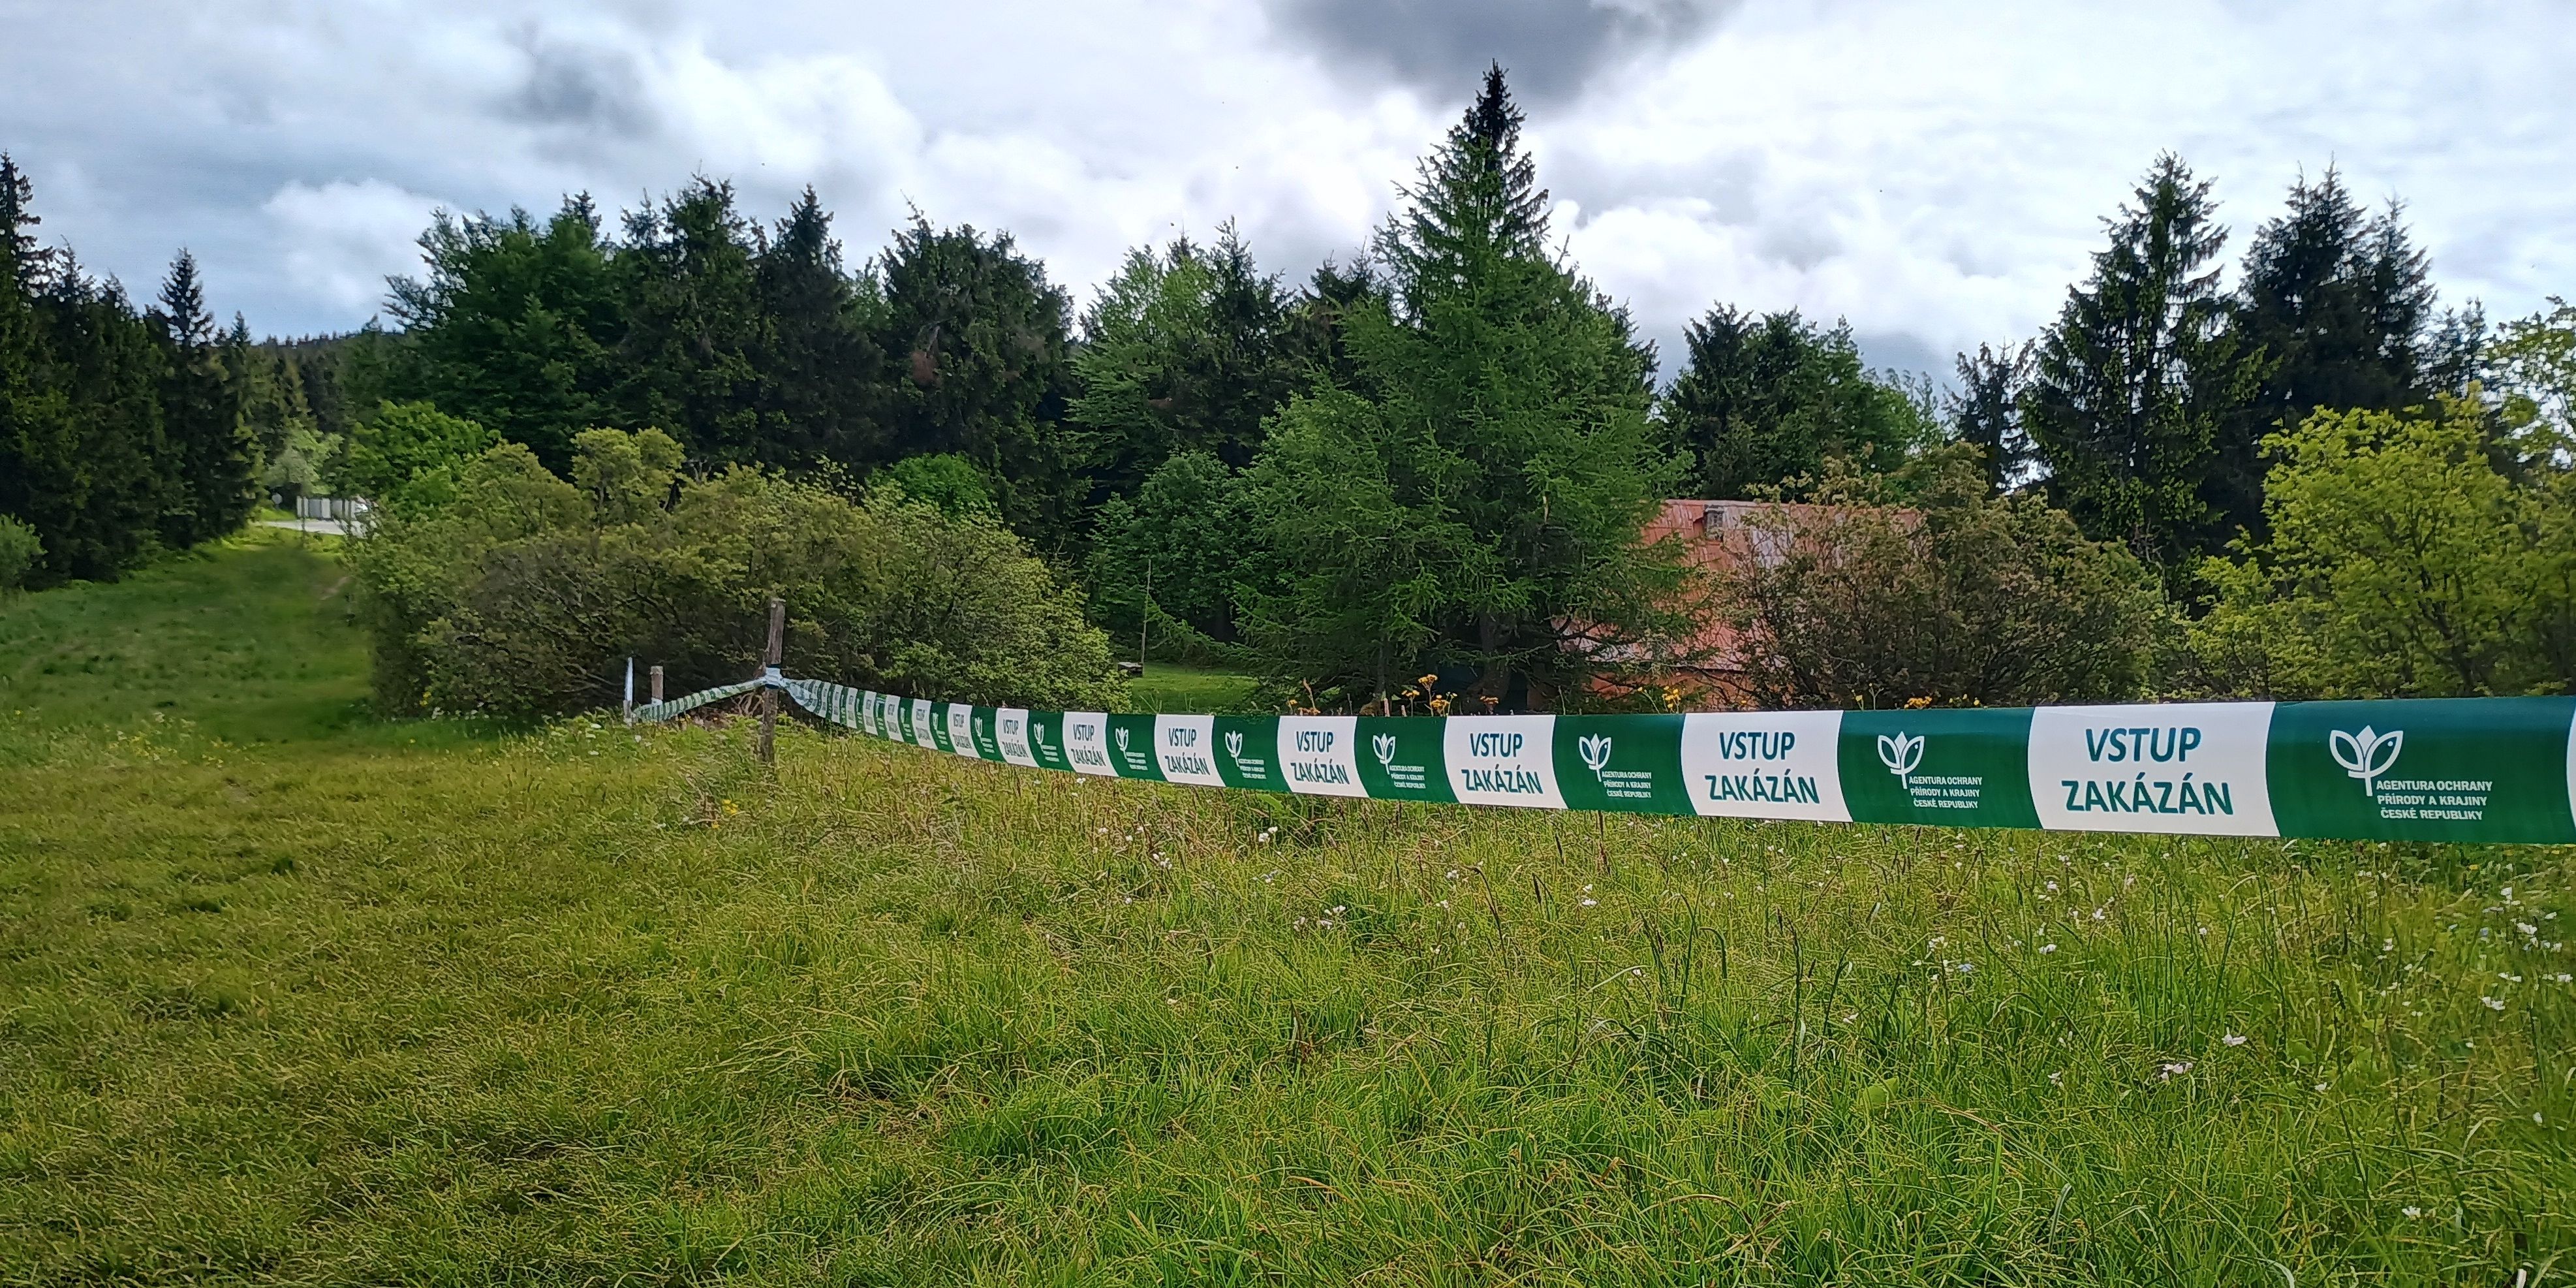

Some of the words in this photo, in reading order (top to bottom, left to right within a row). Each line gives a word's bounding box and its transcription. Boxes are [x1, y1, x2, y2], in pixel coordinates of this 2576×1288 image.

[1002, 719, 1019, 736] VSTUP
[1073, 723, 1094, 742] VSTUP
[1168, 727, 1197, 747] VSTUP
[1296, 730, 1334, 753] VSTUP
[1470, 732, 1523, 758] VSTUP
[1719, 731, 1795, 761] VSTUP
[2085, 727, 2201, 762] VSTUP
[1071, 745, 1106, 767] ZAKÁZÁN
[1164, 753, 1211, 776] ZAKÁZÁN
[1290, 758, 1350, 785] ZAKÁZÁN
[1461, 763, 1544, 794] ZAKÁZÁN
[1909, 776, 1947, 785] AGENTURA
[1947, 777, 1982, 785] OCHRANY
[1704, 768, 1820, 804] ZAKÁZÁN
[1910, 786, 1941, 796] PŘÍRODY
[1949, 789, 1979, 797] KRAJINY
[2061, 772, 2233, 815] ZAKÁZÁN
[2376, 780, 2436, 791] AGENTURA
[2436, 781, 2492, 791] OCHRANY
[1914, 798, 1938, 808] ČESKÉ
[1938, 800, 1978, 809] REPUBLIKY
[2377, 793, 2425, 805] PŘÍRODY
[2429, 796, 2437, 805] A
[2439, 796, 2487, 806] KRAJINY
[2380, 807, 2418, 819] ČESKÉ
[2419, 809, 2483, 821] REPUBLIKY
